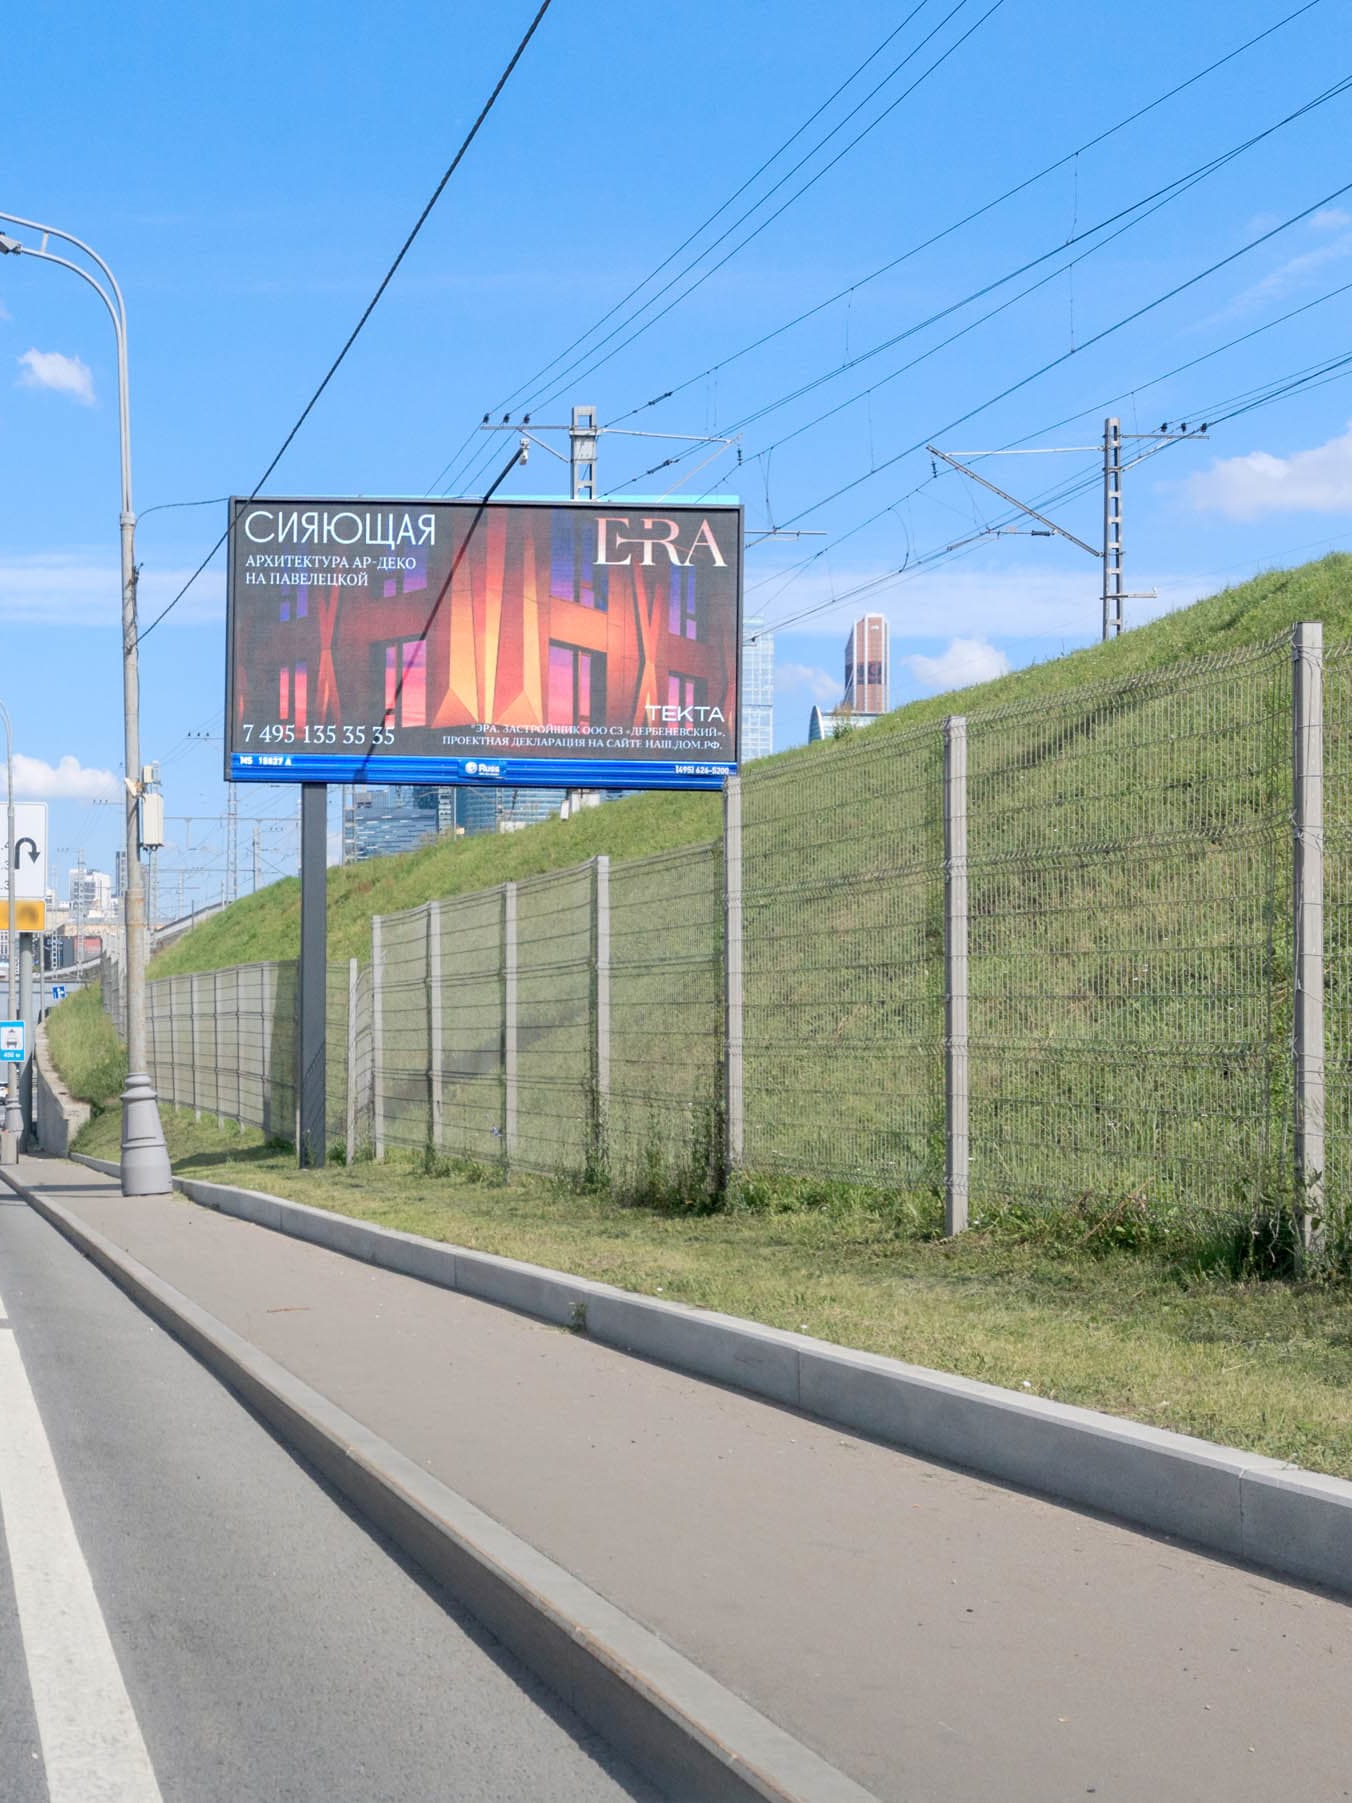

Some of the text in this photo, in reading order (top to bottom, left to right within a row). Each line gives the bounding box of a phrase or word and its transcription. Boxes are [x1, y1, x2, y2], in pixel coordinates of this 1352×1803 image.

[245, 511, 435, 550] СИЯЮЩАЯ
[593, 517, 728, 567] ERA
[246, 554, 416, 571] АРХИТЕКТУРА АР-ДЕКО
[246, 571, 368, 587] НА ПАВЕЛЕЦКОЙ
[645, 705, 725, 723] ТЕКТА
[243, 724, 395, 745] 7 495 135 35 35
[582, 726, 607, 735] ООО
[609, 726, 623, 735] СЗ
[443, 735, 509, 746] ПРОЕКТНАЯ
[510, 737, 585, 748] ДЕКЛАРАЦИЯ
[588, 738, 604, 747] НА
[606, 738, 642, 748] САЙТЕ
